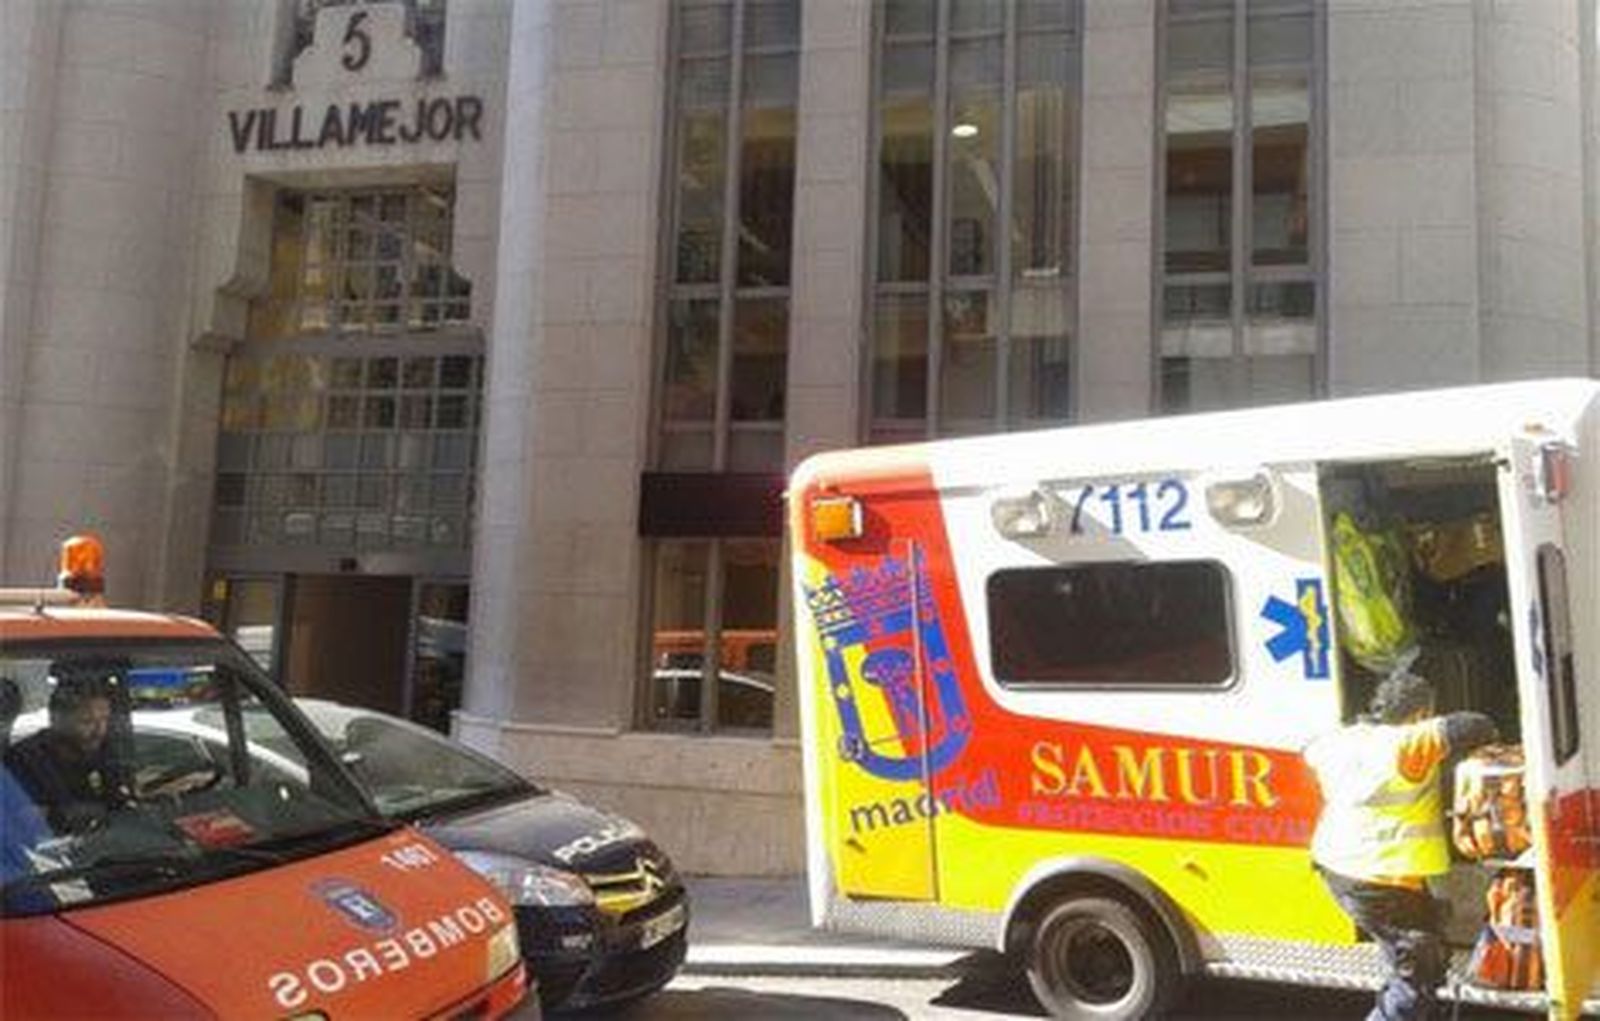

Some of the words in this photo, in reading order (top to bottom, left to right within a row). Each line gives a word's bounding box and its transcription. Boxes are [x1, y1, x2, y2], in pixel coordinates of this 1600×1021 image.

[342, 11, 372, 72] 5
[228, 96, 483, 153] VILLAMEJOR
[849, 770, 999, 834] madrid
[1030, 740, 1281, 809] SAMUR
